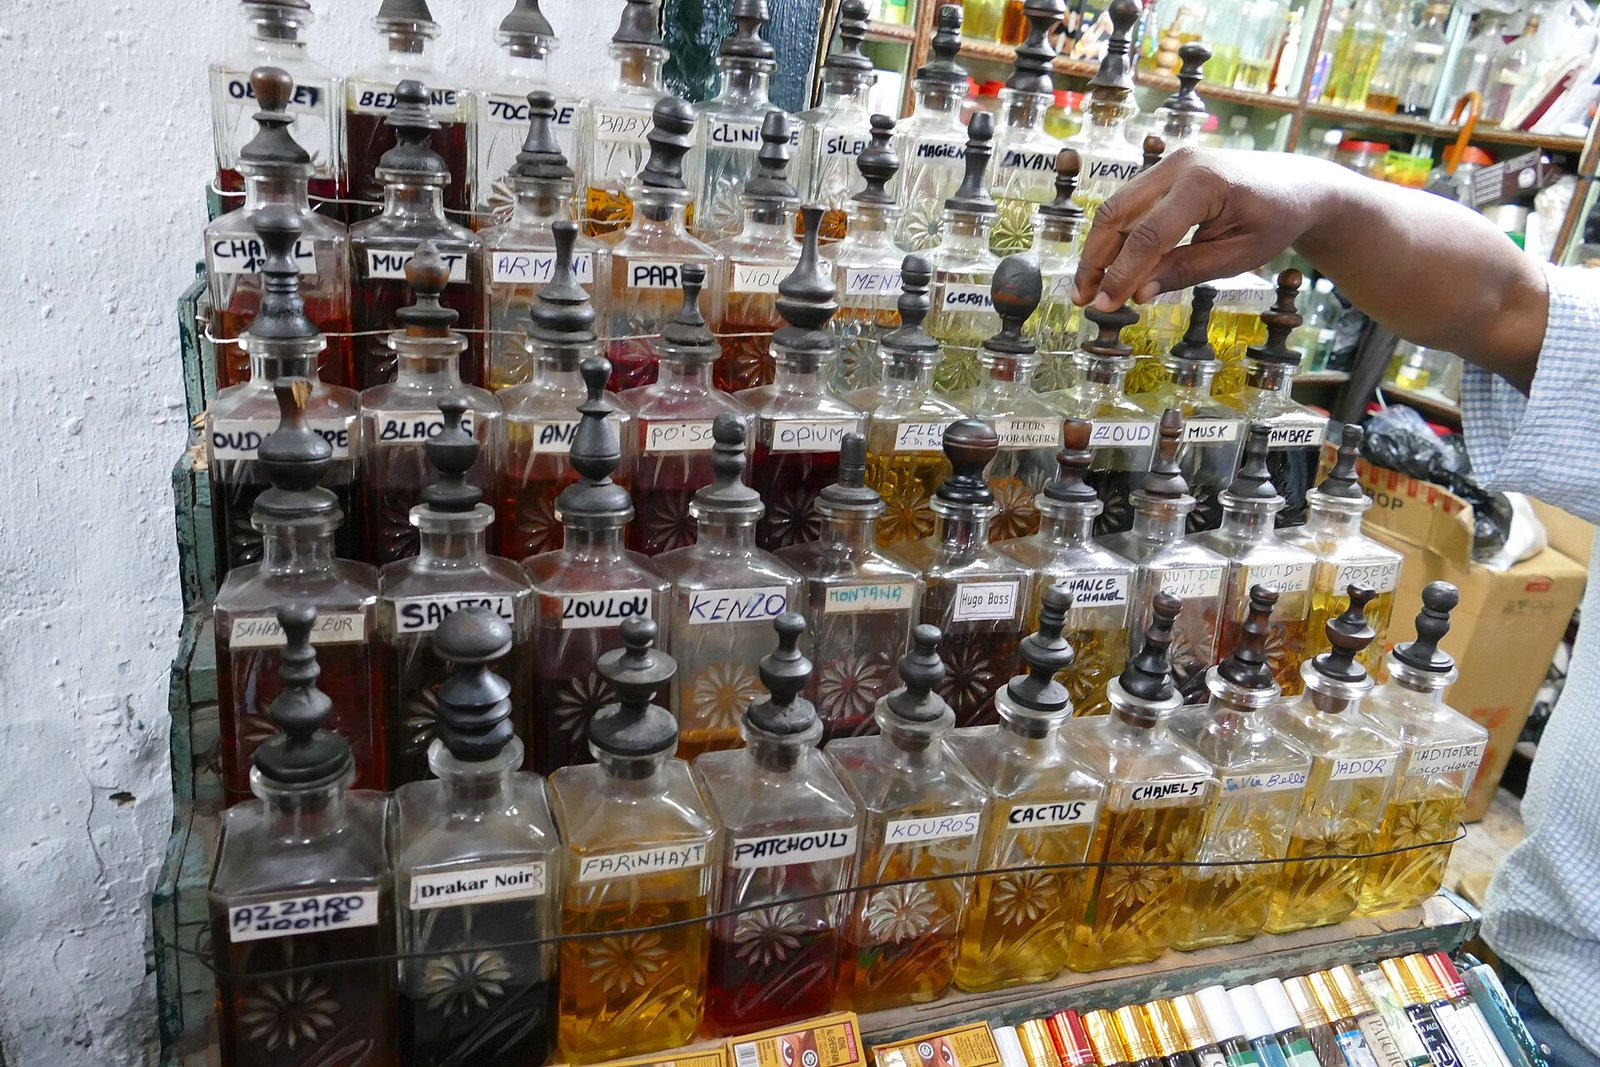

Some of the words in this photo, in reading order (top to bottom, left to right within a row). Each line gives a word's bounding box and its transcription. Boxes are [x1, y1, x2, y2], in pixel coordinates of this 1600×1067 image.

[1011, 421, 1046, 430] FLEURS
[1188, 425, 1229, 439] MUSK
[213, 431, 261, 451] OUD
[1270, 429, 1315, 443] AMBRE
[829, 586, 903, 603] MONTANA
[961, 593, 984, 608] Hugo
[987, 592, 1010, 605] Boss
[562, 596, 648, 618] LOULOU
[689, 594, 787, 623] KENZO
[1132, 784, 1189, 800] CHANEL
[1189, 781, 1204, 796] 5
[1009, 802, 1086, 824] CACTUS
[891, 815, 977, 838] KOUROS
[421, 878, 489, 898] Drakar
[495, 870, 533, 888] Noir
[234, 896, 363, 927] AZZARO
